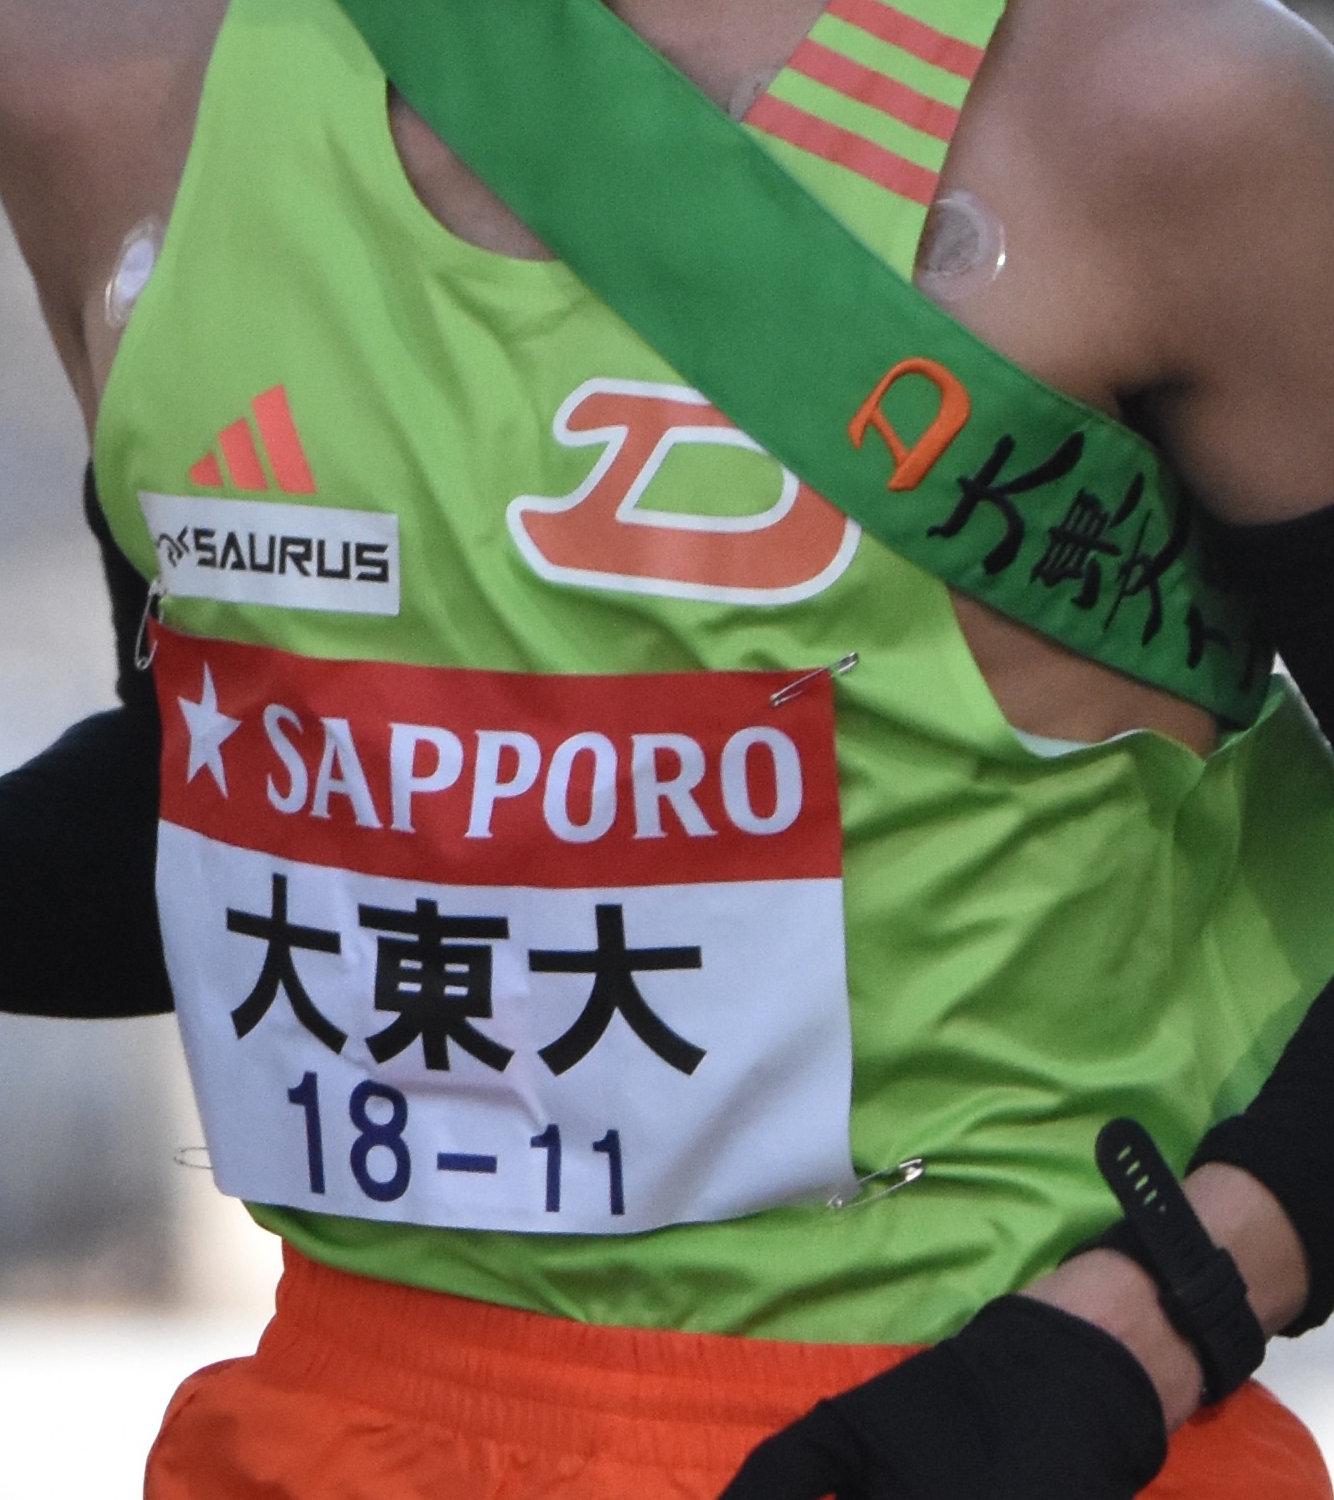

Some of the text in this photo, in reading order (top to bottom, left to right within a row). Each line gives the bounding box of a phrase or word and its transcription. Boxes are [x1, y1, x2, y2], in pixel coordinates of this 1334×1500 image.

[506, 377, 860, 605] D
[848, 357, 972, 492] D
[264, 703, 804, 842] SAPPORO
[226, 873, 707, 1077] 大東大
[287, 1071, 626, 1217] 18-11
